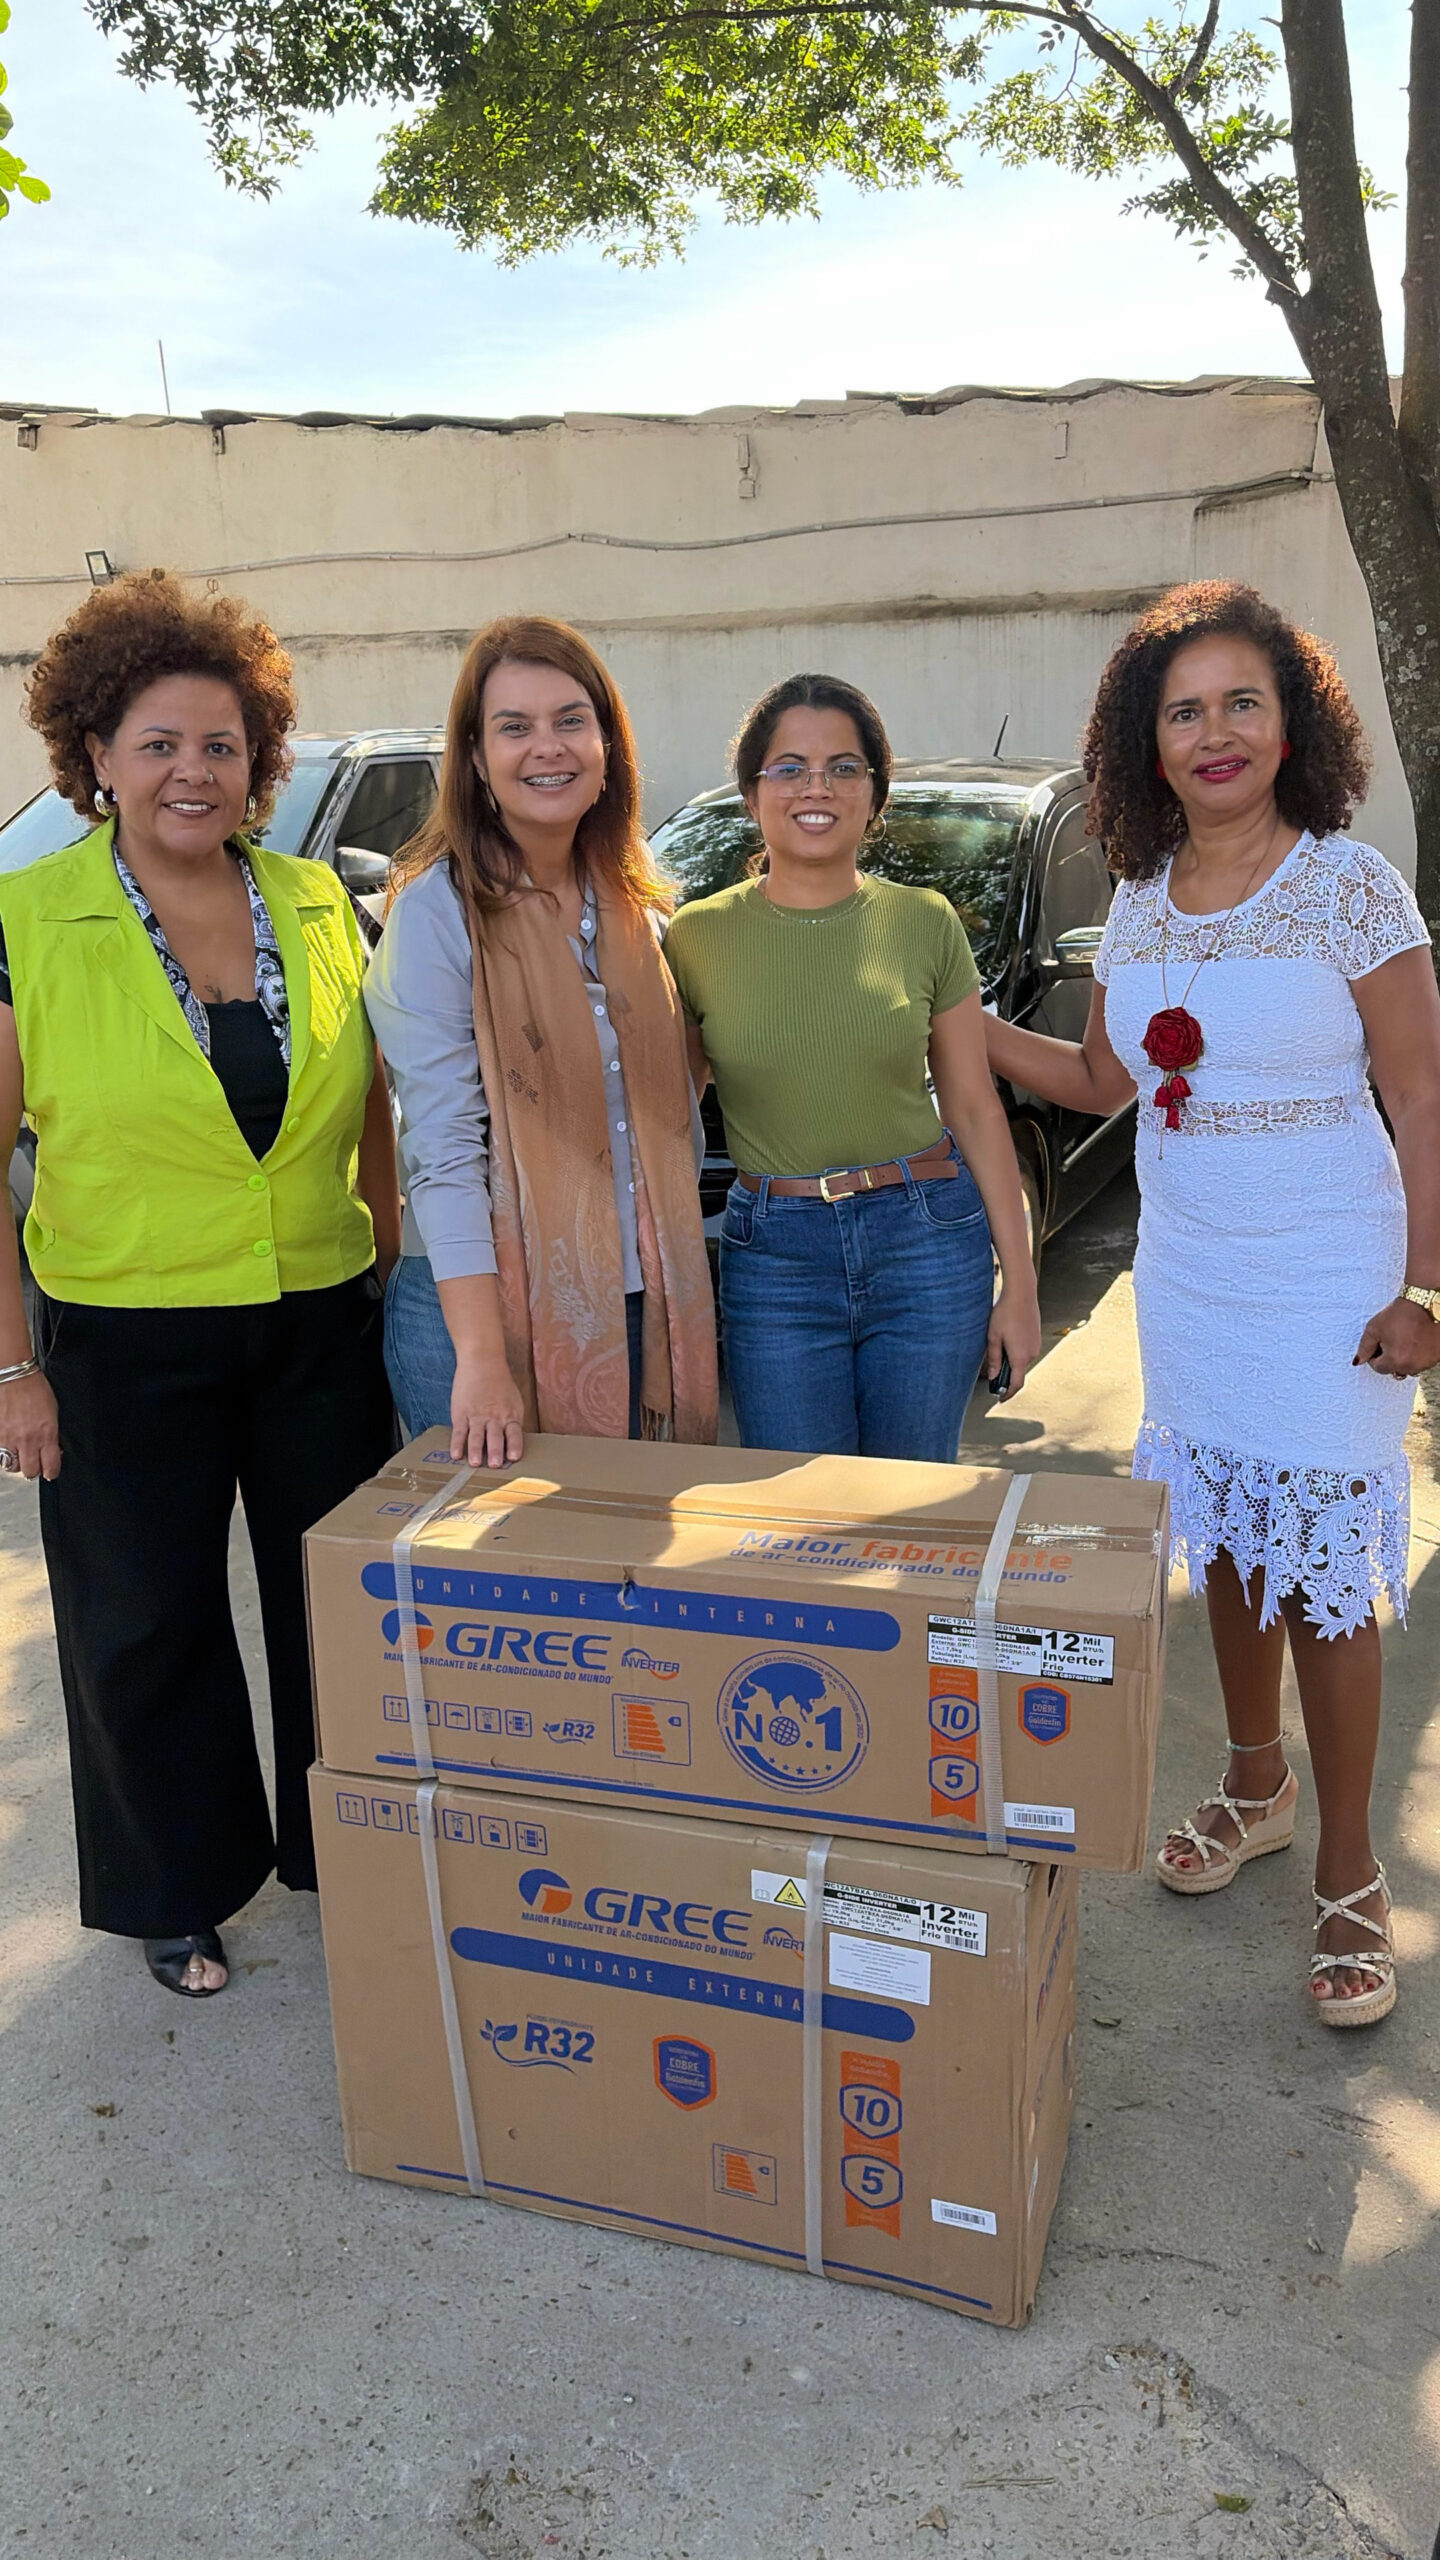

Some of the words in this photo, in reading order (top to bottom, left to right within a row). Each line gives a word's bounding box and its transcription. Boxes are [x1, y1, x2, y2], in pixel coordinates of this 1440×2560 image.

[729, 1548, 754, 1558] de
[762, 1551, 944, 1574] ar-condicionado
[952, 1565, 979, 1577] do
[737, 1531, 851, 1555] Maior
[861, 1541, 1073, 1570] fabricnte
[416, 1578, 587, 1606] UNIDADE
[654, 1601, 835, 1633] INTERNA
[445, 1622, 612, 1671] GREE
[1045, 1631, 1080, 1652] 12
[1083, 1637, 1101, 1646] Mil
[384, 1652, 404, 1662] MAIO
[420, 1656, 465, 1669] ABRICANTE
[467, 1662, 478, 1671] DE
[480, 1663, 561, 1680] AR-CONDICIONADO
[564, 1670, 576, 1680] DO
[621, 1656, 680, 1673] INVERTER
[1042, 1662, 1064, 1671] Frio
[1043, 1650, 1104, 1667] Inverter
[940, 1704, 970, 1730] 10
[1032, 1703, 1057, 1713] COBRE
[563, 1721, 595, 1739] R32
[944, 1763, 965, 1789] 5
[823, 1882, 917, 1905] WC12ATBXA-D6DNA1A/O
[584, 1887, 752, 1947] GREE
[923, 1903, 956, 1925] 12
[958, 1911, 975, 1921] Mil
[521, 1912, 550, 1924] MAIOR
[552, 1917, 603, 1934] FABRICANTE
[606, 1926, 618, 1936] DE
[620, 1928, 702, 1950] AR-CONDICIONADO
[704, 1944, 717, 1954] DO
[763, 1934, 804, 1951] INVERT
[921, 1929, 941, 1940] Frio
[922, 1919, 979, 1940] Inverter
[547, 1953, 654, 1983] UNIDADE
[688, 1977, 801, 2011] EXTERNA
[524, 2021, 595, 2063] R32
[669, 2057, 701, 2073] COBRE
[853, 2094, 890, 2127] 10
[861, 2165, 885, 2195] 5
